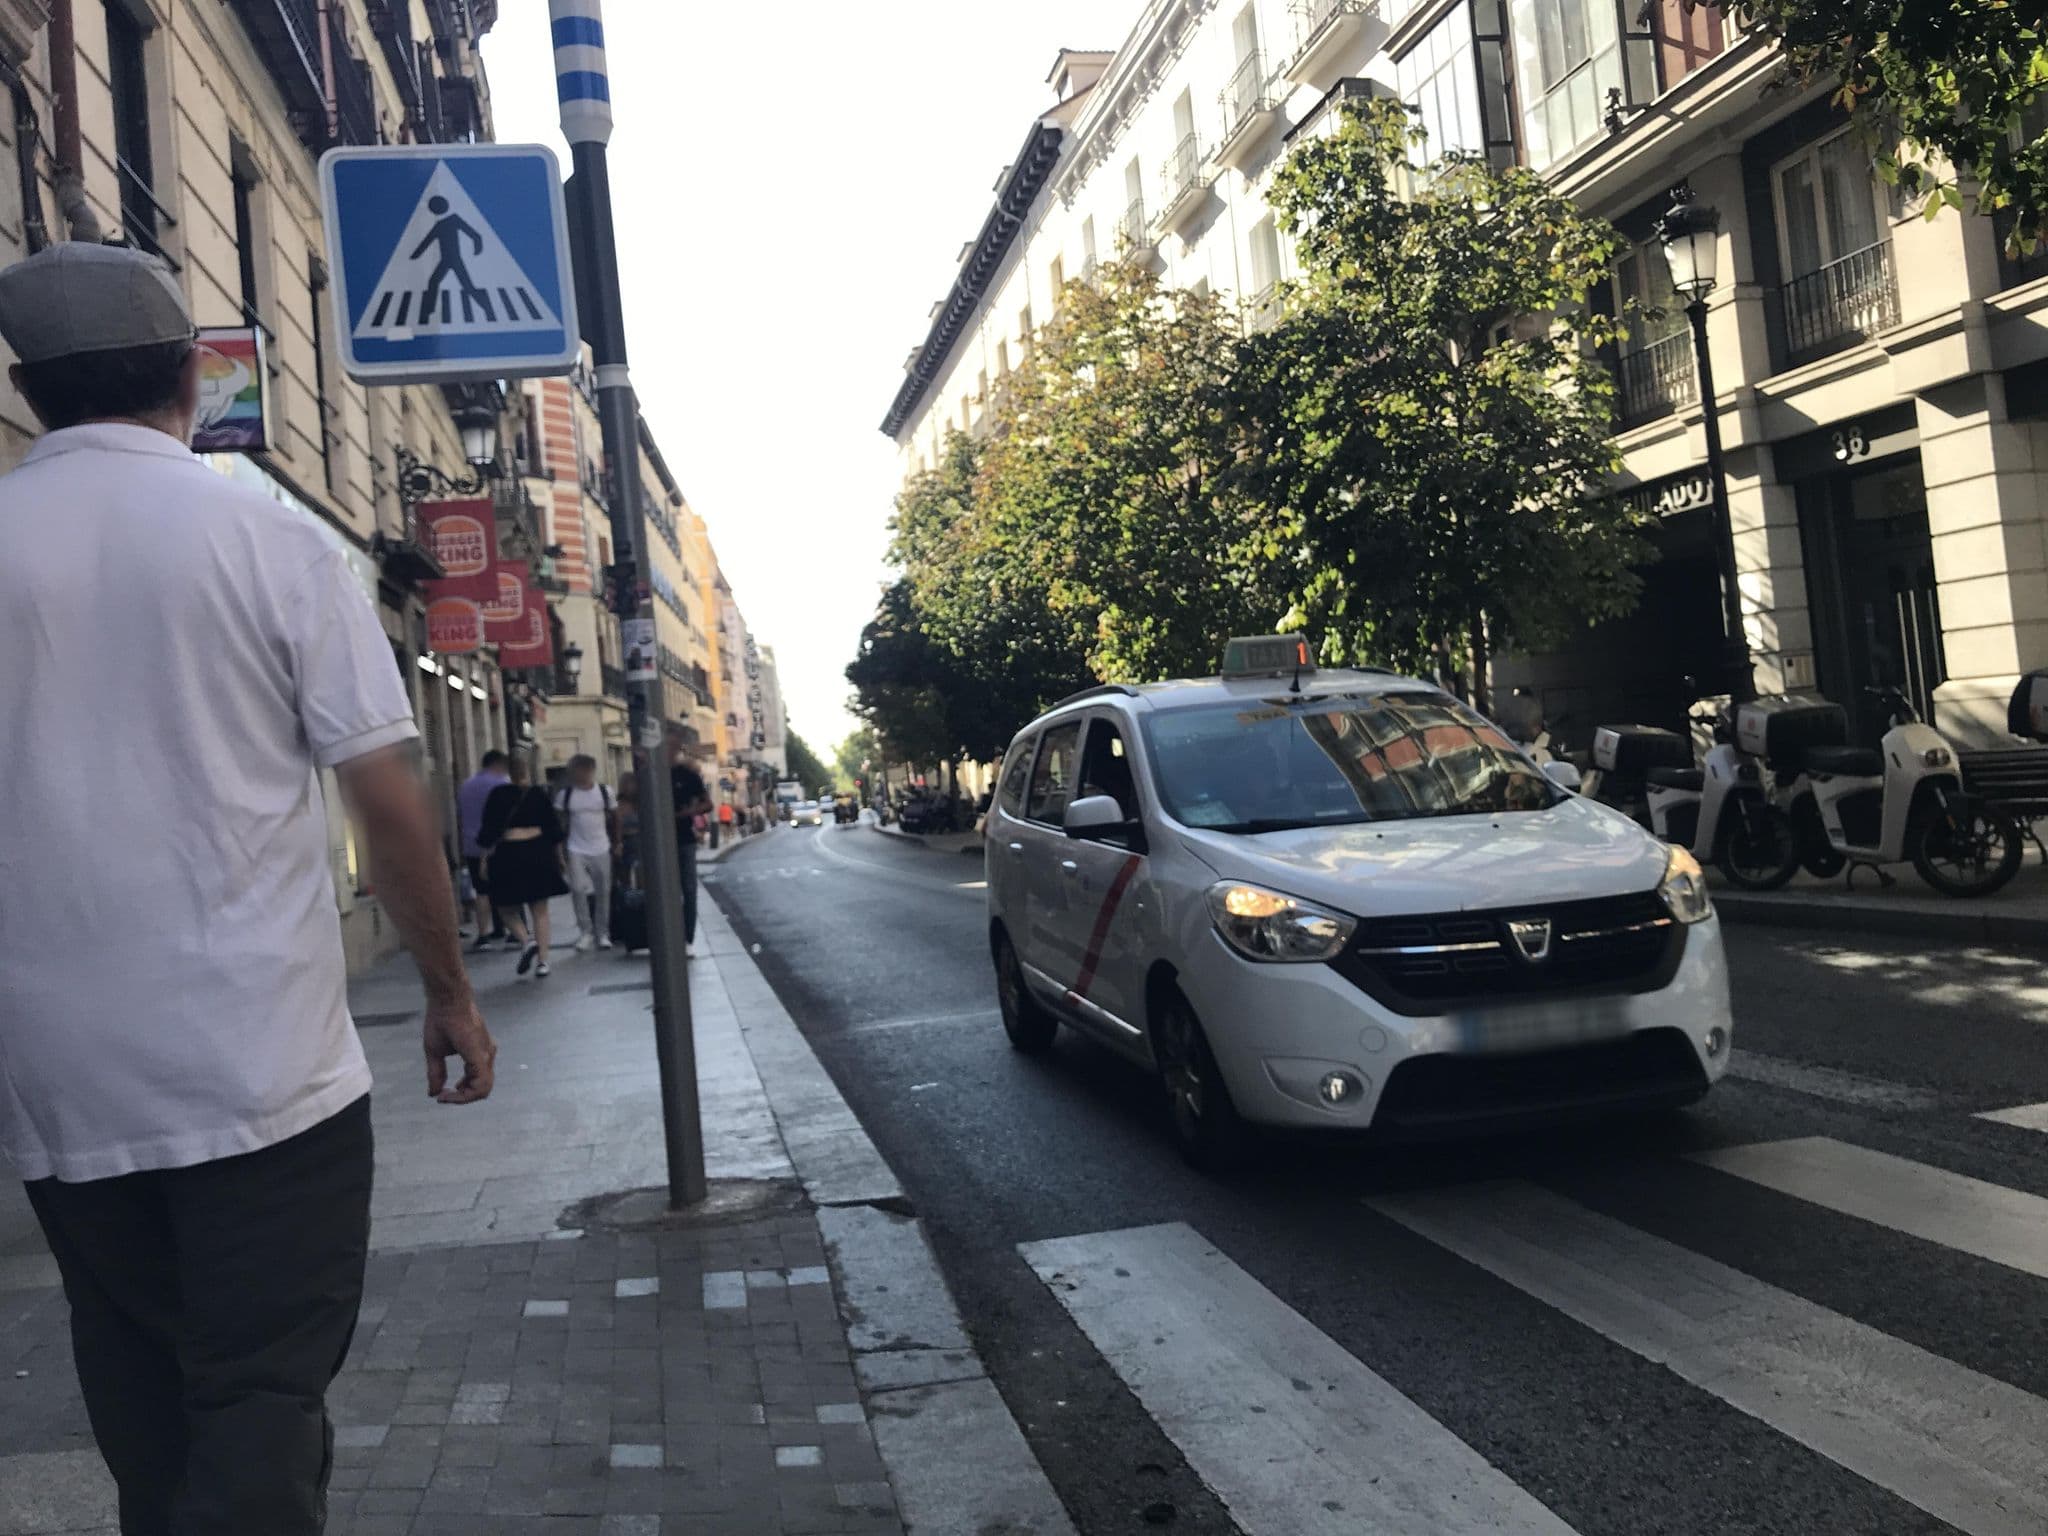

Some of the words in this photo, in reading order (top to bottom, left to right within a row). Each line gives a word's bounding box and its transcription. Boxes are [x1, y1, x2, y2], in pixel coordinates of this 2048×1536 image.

[1832, 426, 1863, 460] 38
[432, 546, 483, 562] KING
[430, 625, 478, 641] KING
